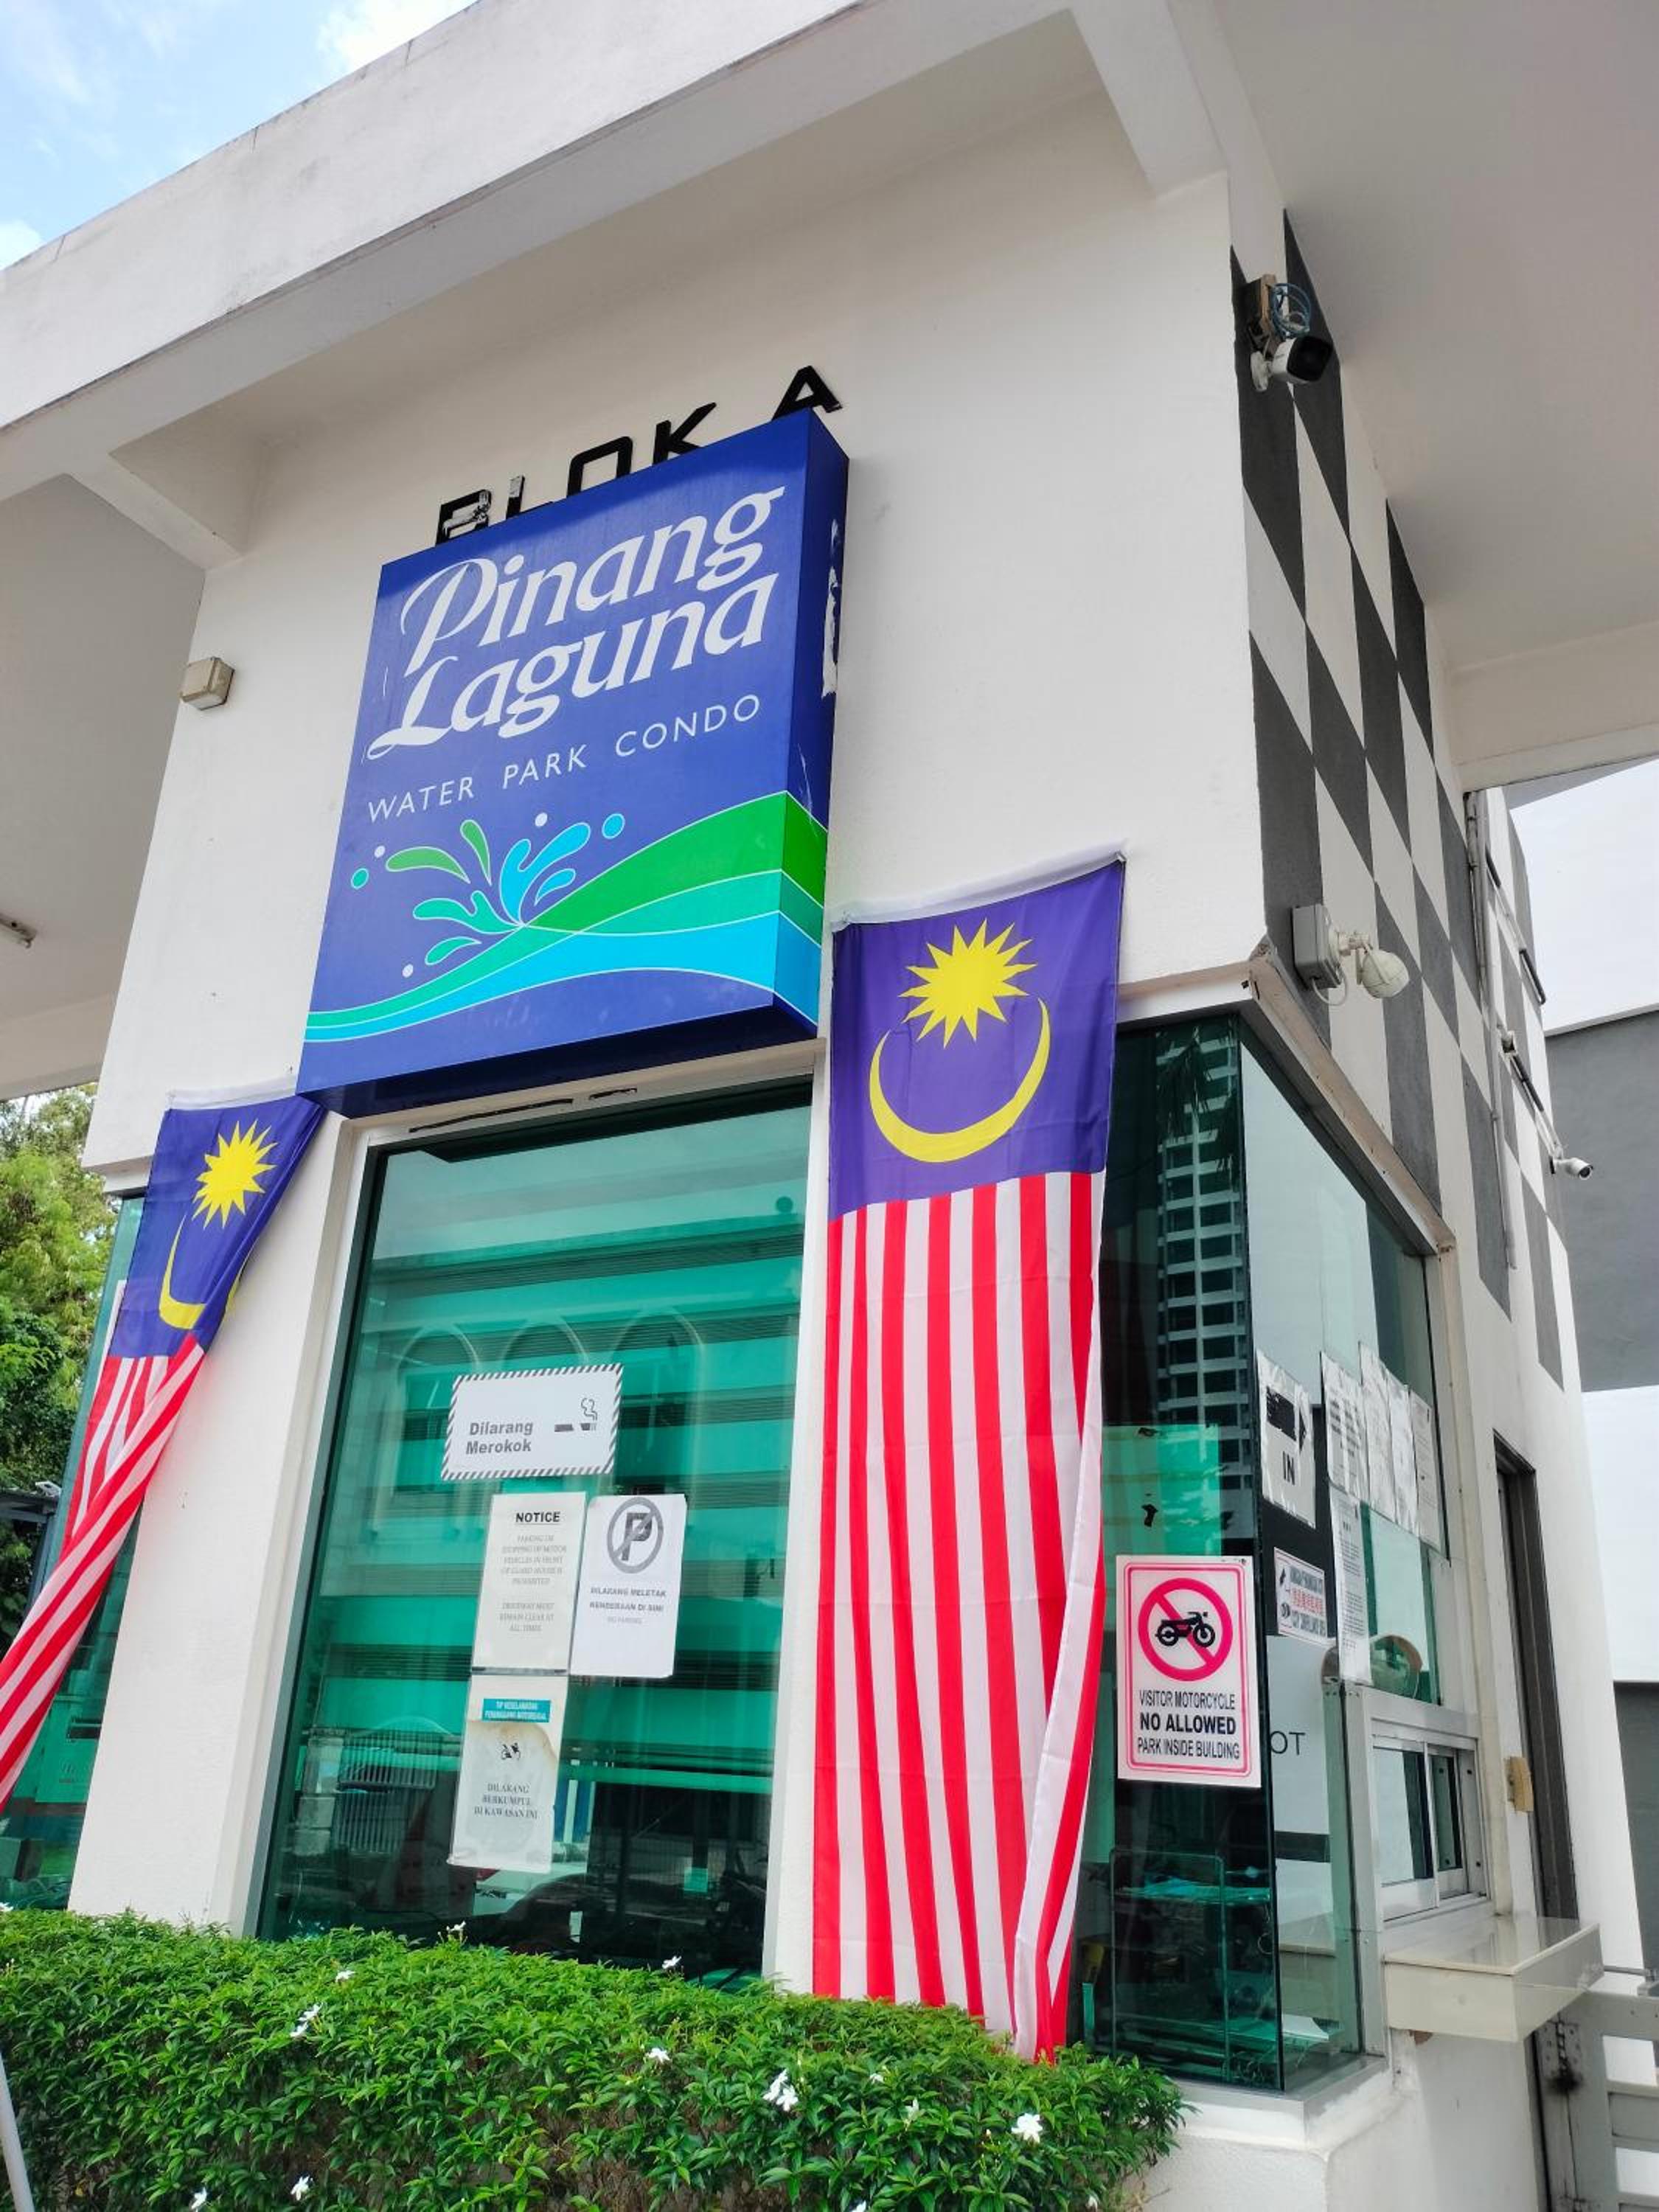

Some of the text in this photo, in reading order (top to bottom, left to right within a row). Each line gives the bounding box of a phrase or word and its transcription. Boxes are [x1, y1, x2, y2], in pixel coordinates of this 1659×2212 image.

[771, 365, 843, 420] A
[400, 486, 785, 677] Pinang
[367, 573, 779, 759] Laguna
[368, 694, 759, 822] WATER PARK CONDO
[470, 1422, 533, 1436] Dilarang
[465, 1439, 531, 1454] Merokok
[1282, 1450, 1295, 1485] IN
[515, 1512, 560, 1523] NOTICE
[1139, 1689, 1235, 1710] VISITOR MOTORCYCLE
[1140, 1712, 1237, 1735] NO ALLOWED
[1138, 1737, 1239, 1760] PARK INSIDE BUILDING
[487, 1783, 530, 1793] DILARANG
